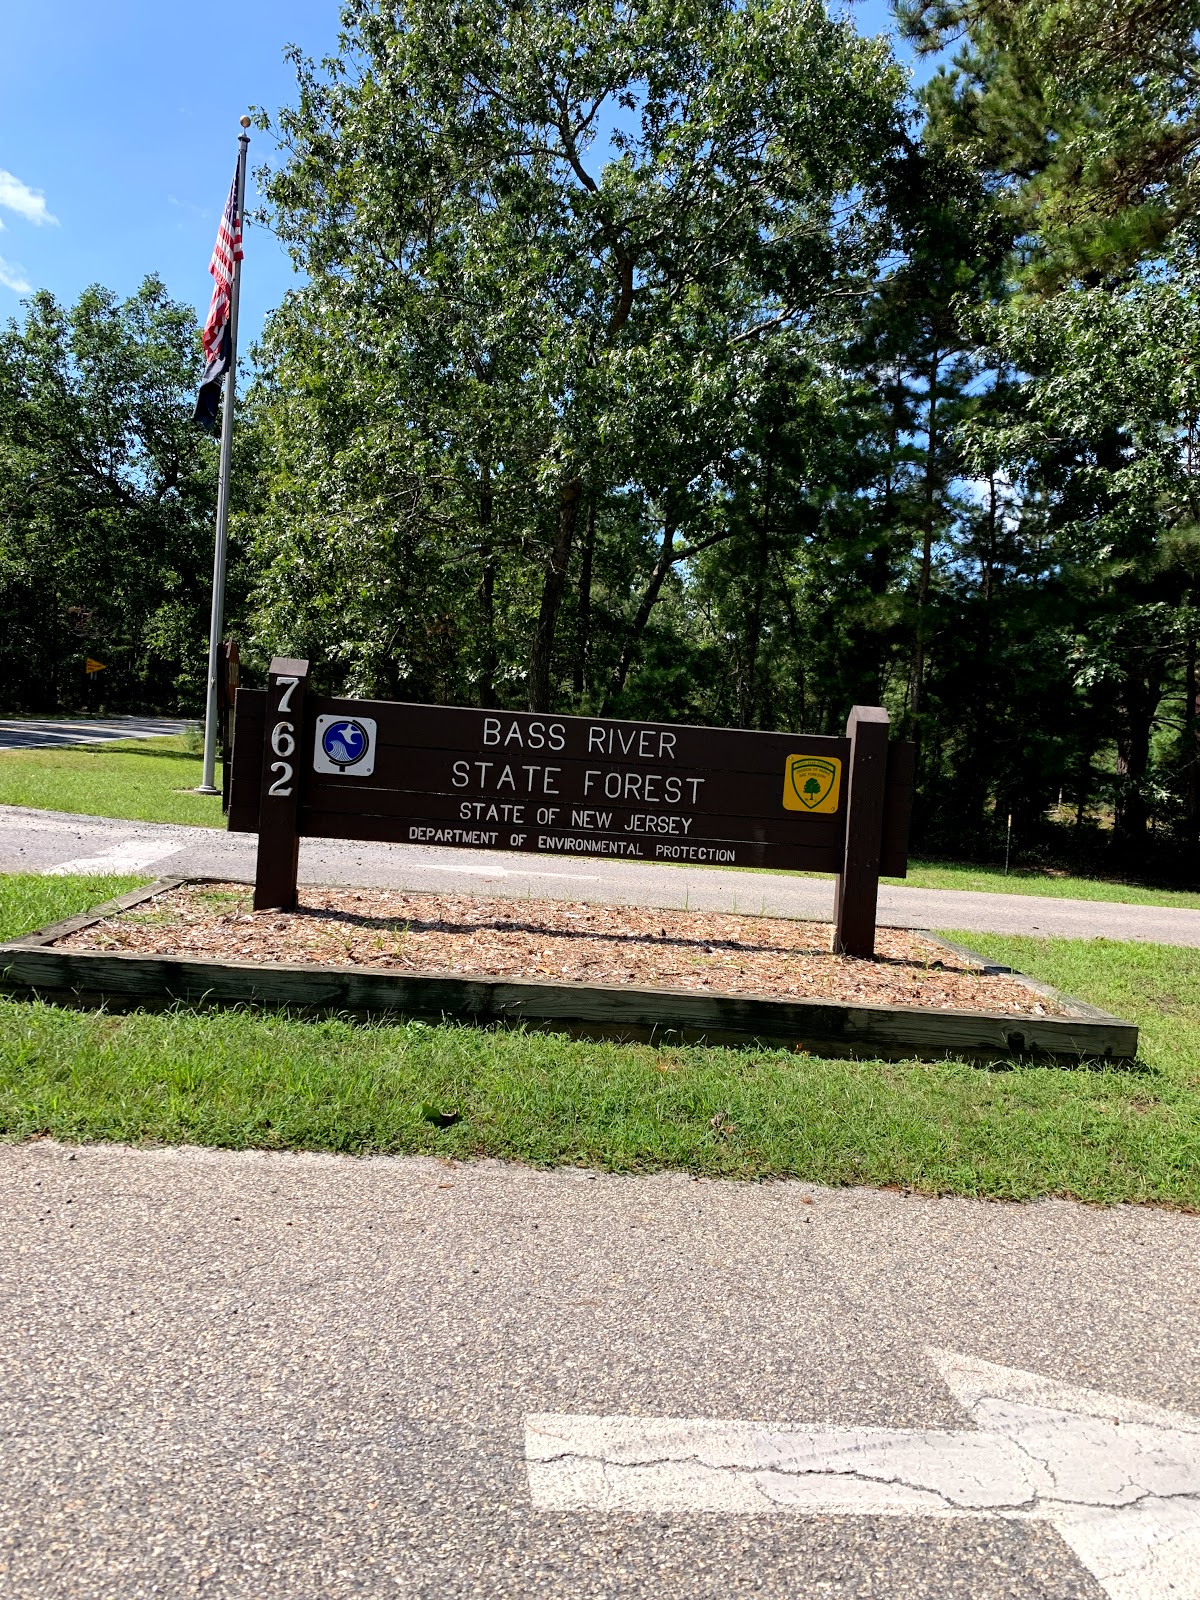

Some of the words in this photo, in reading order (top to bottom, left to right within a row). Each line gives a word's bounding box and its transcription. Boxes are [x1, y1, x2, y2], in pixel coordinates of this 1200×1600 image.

[483, 717, 566, 751] BASS
[588, 726, 677, 759] RIVER
[452, 760, 562, 794] STATE
[584, 770, 706, 804] FOREST
[459, 802, 525, 825] STATE
[536, 807, 561, 826] OF
[571, 809, 613, 829] NEW
[624, 814, 693, 836] JERSEY
[409, 826, 499, 846] DEPARTMENT
[510, 833, 527, 847] OF
[538, 835, 644, 856] ENVIRONMENTAL
[655, 844, 736, 863] PROTECTION
